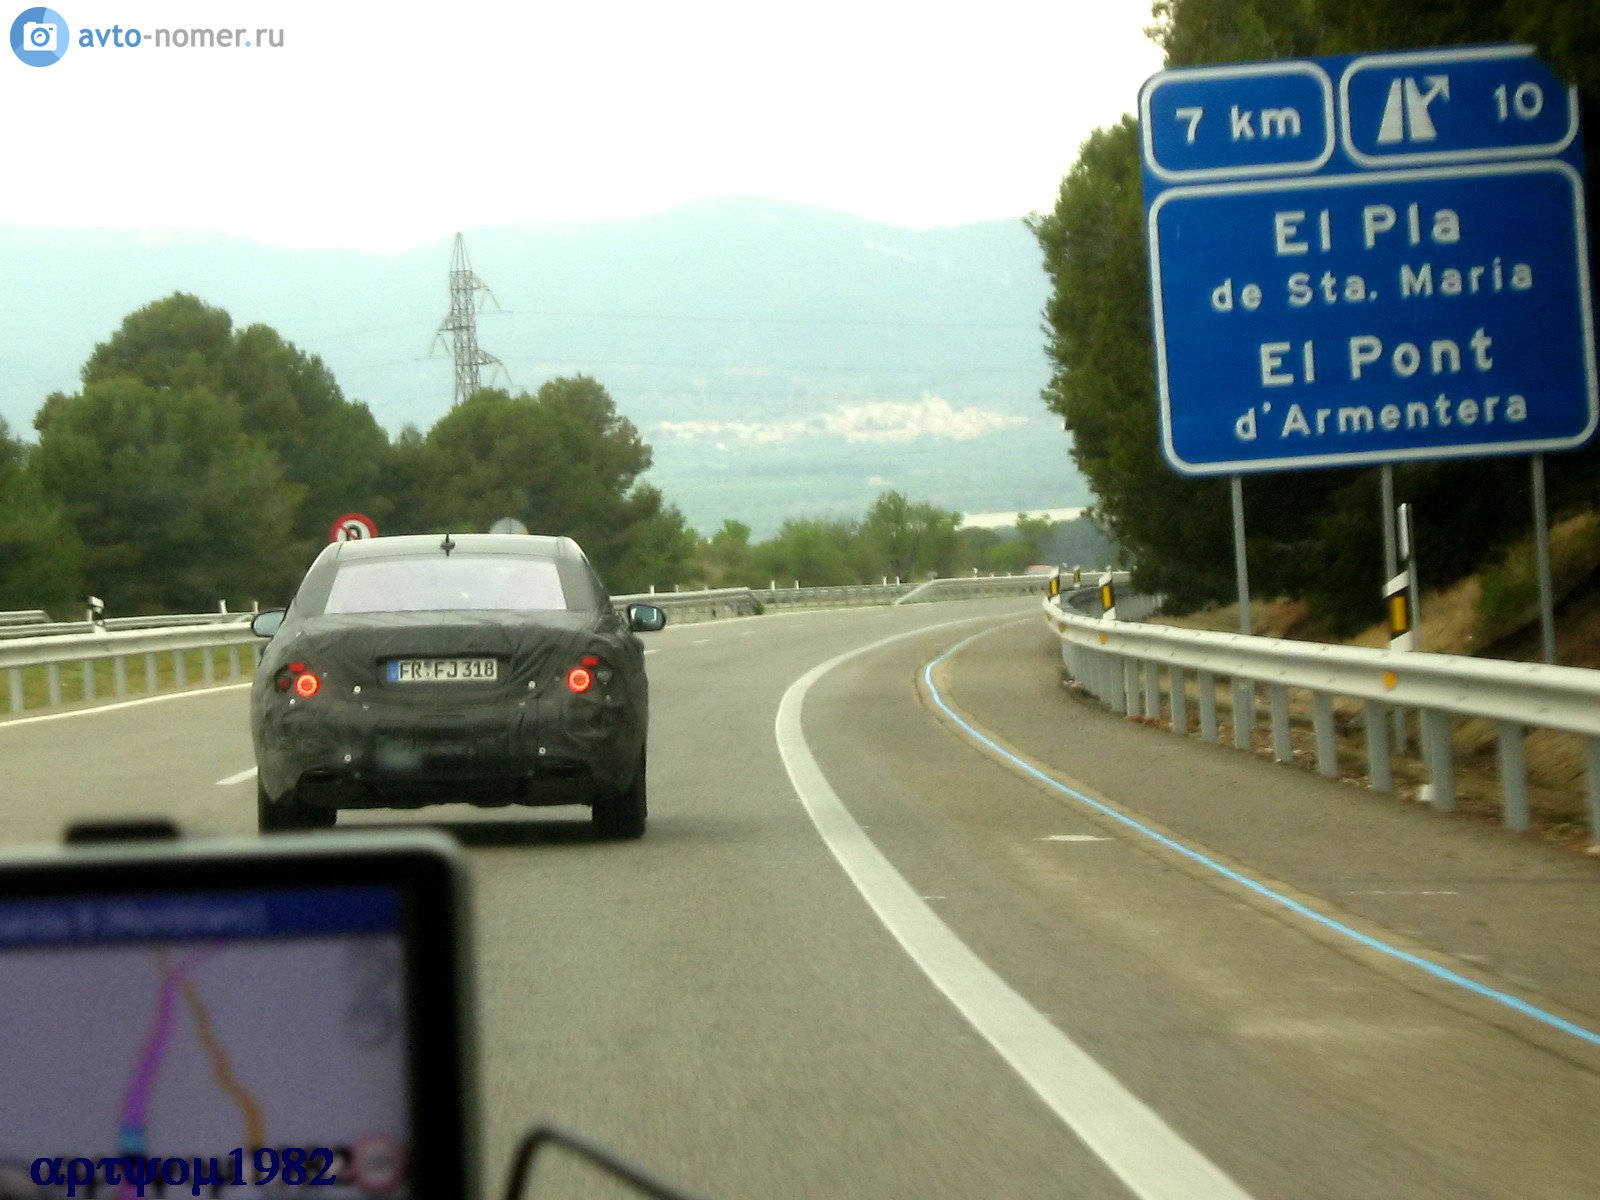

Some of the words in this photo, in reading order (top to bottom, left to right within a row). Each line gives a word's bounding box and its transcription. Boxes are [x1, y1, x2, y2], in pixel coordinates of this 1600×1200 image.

[1494, 82, 1544, 122] 10
[1175, 107, 1203, 143] 7
[1230, 105, 1301, 141] km
[1274, 208, 1331, 255] El
[1363, 203, 1461, 248] Pla
[1211, 279, 1263, 311] de
[1288, 271, 1378, 306] Sta.
[1260, 340, 1315, 387] El
[1349, 328, 1494, 380] Pont
[1234, 394, 1528, 441] d'Armentera
[462, 660, 495, 678] 318
